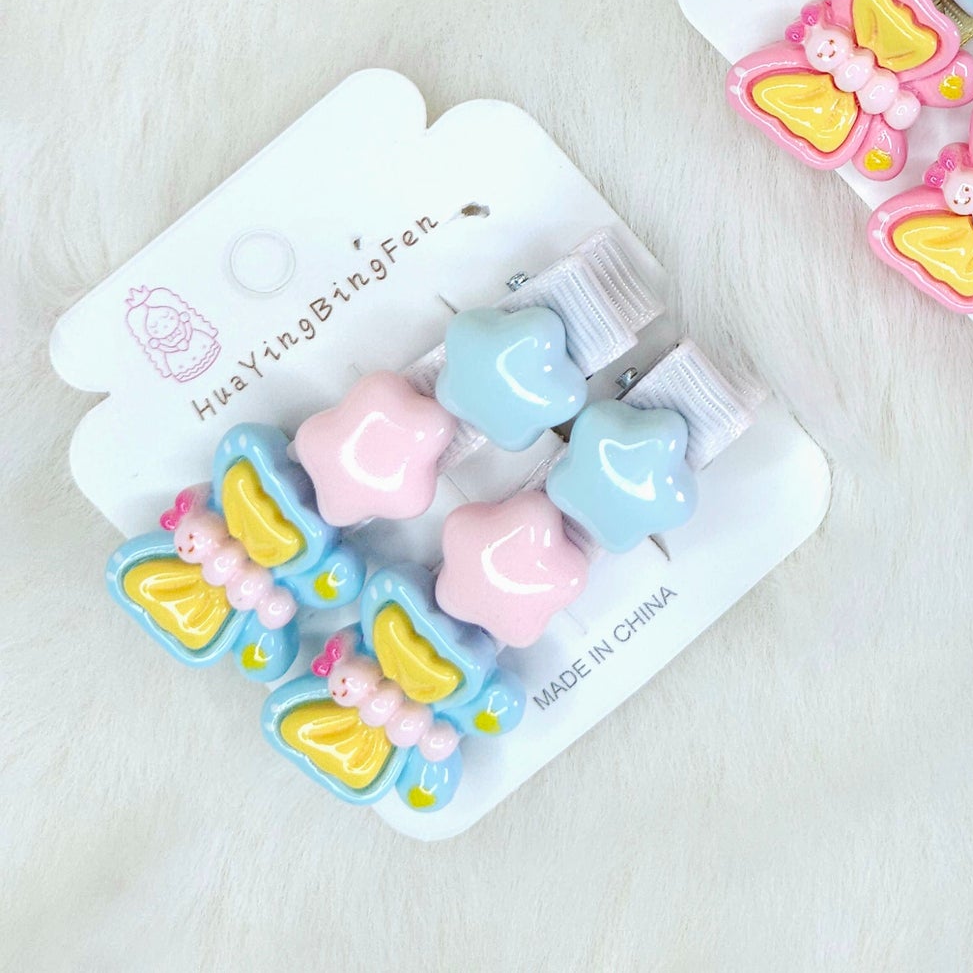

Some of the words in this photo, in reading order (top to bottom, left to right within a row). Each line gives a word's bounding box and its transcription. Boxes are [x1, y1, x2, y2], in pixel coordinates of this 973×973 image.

[191, 215, 439, 421] HuaYingBingFen
[532, 658, 592, 711] MADE
[588, 639, 614, 665] IN
[613, 586, 678, 642] CHINA
